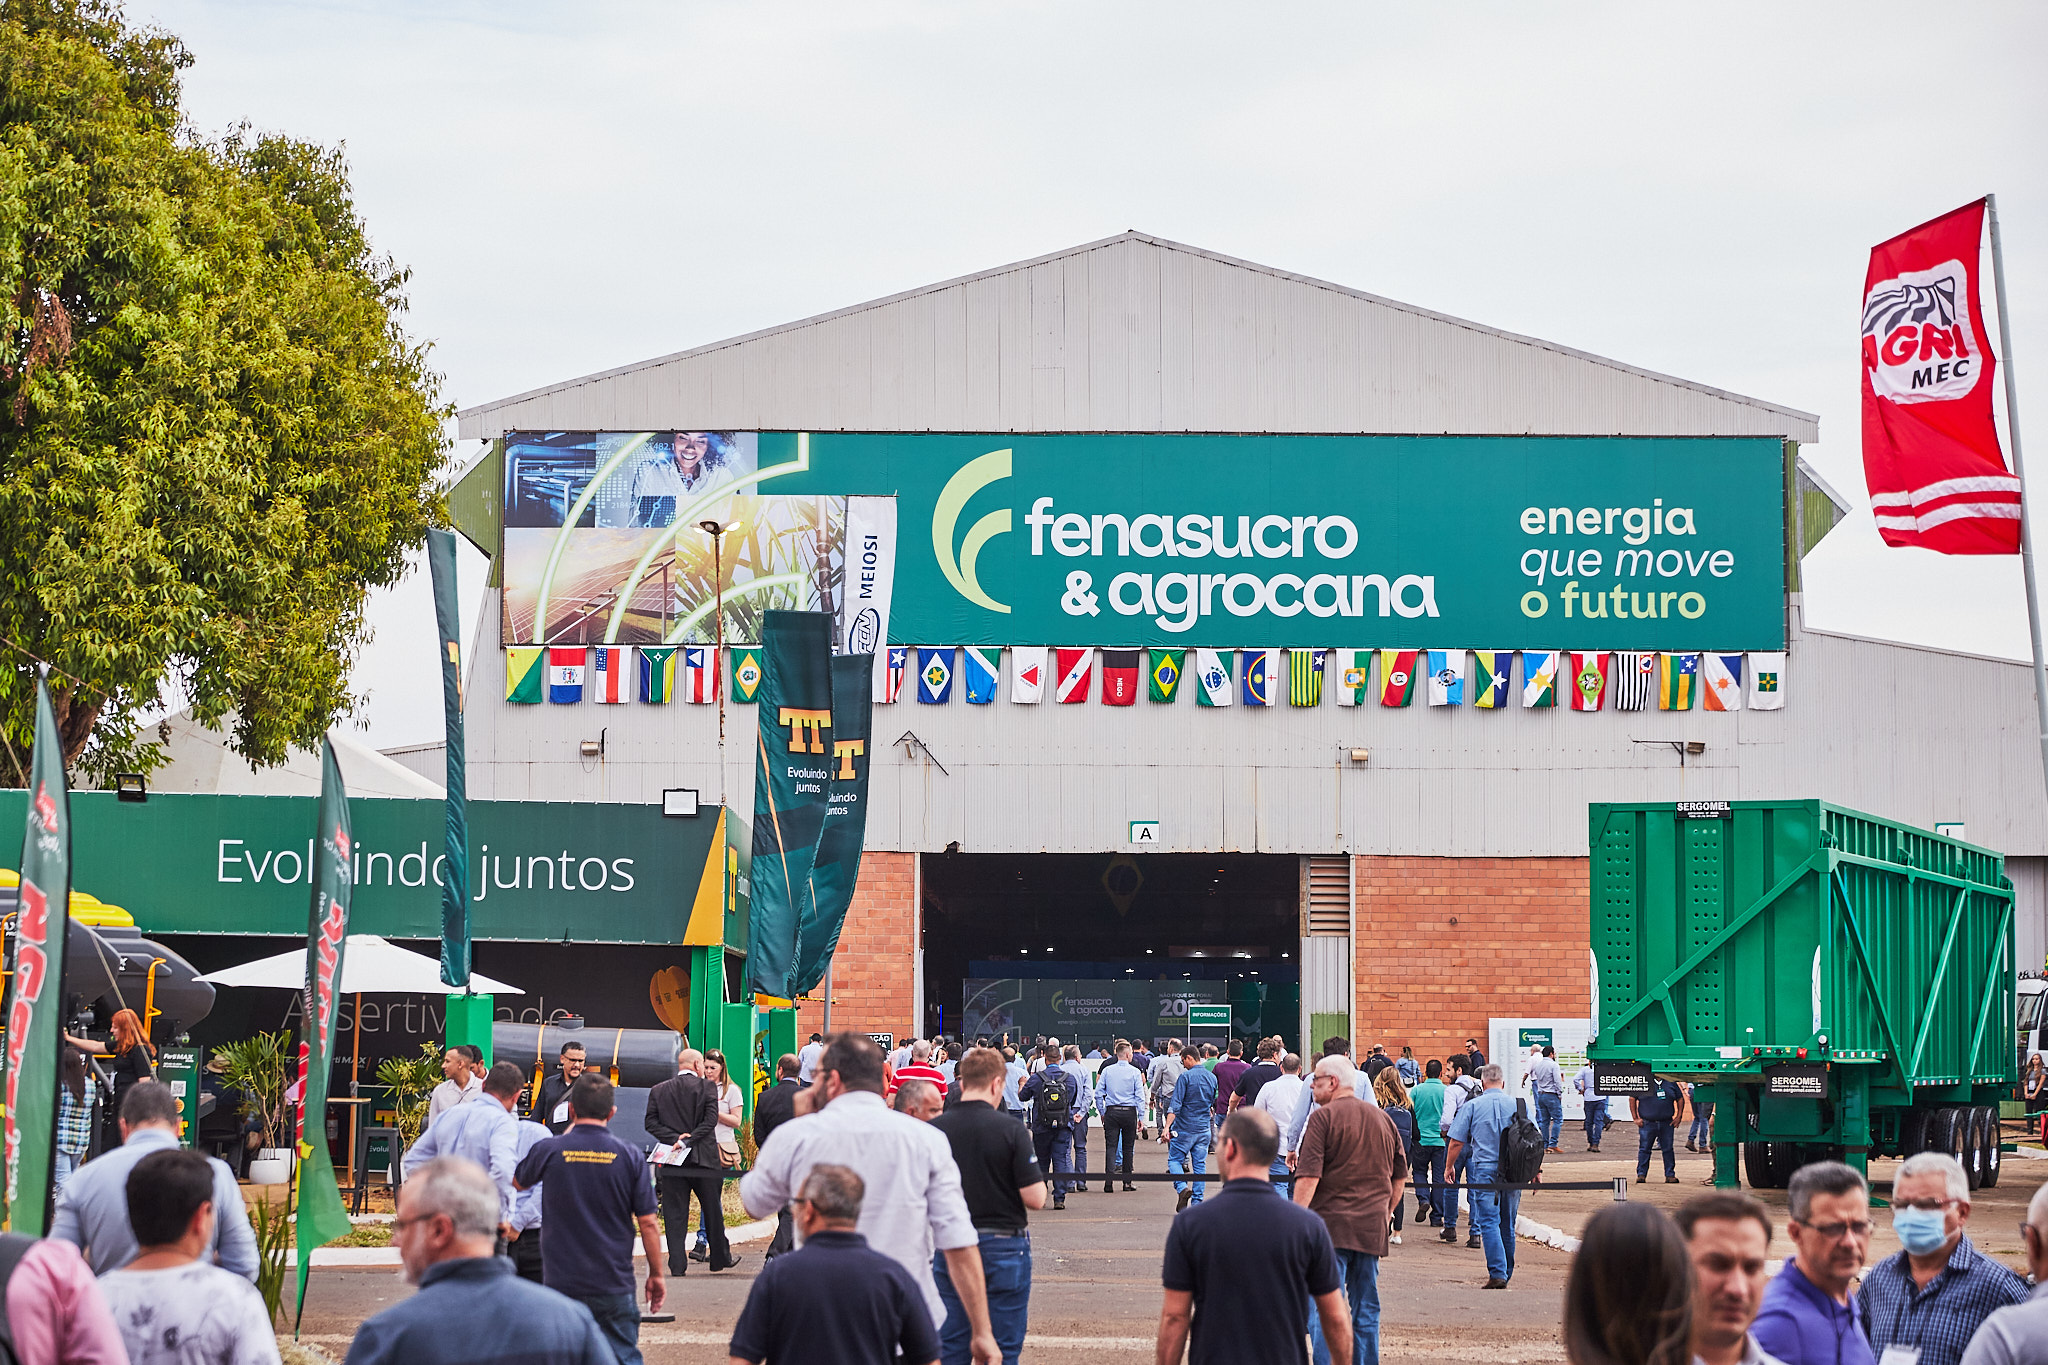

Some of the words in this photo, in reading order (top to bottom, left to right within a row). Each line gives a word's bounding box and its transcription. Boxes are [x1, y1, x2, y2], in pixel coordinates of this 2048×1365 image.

[1911, 359, 1970, 389] MEC
[1025, 497, 1358, 558] fenasucro
[1520, 499, 1696, 545] energia
[859, 535, 878, 599] MEIOSI
[1521, 549, 1603, 582] que
[1615, 549, 1735, 578] move
[1061, 571, 1100, 616] &
[1108, 571, 1440, 632] agrocana
[1520, 590, 1548, 619] o
[1561, 582, 1706, 619] futuro
[787, 766, 827, 780] Evoluindo
[794, 781, 821, 794] juntos
[1677, 801, 1731, 812] SERGOMEL
[1139, 827, 1152, 840] A
[217, 838, 446, 886] Evolind
[473, 844, 635, 902] juntos
[1064, 996, 1112, 1006] fenasucro
[1076, 1006, 1124, 1016] agrocana
[1600, 1076, 1649, 1084] SERGOMEL
[1771, 1077, 1822, 1085] SERGOMEL
